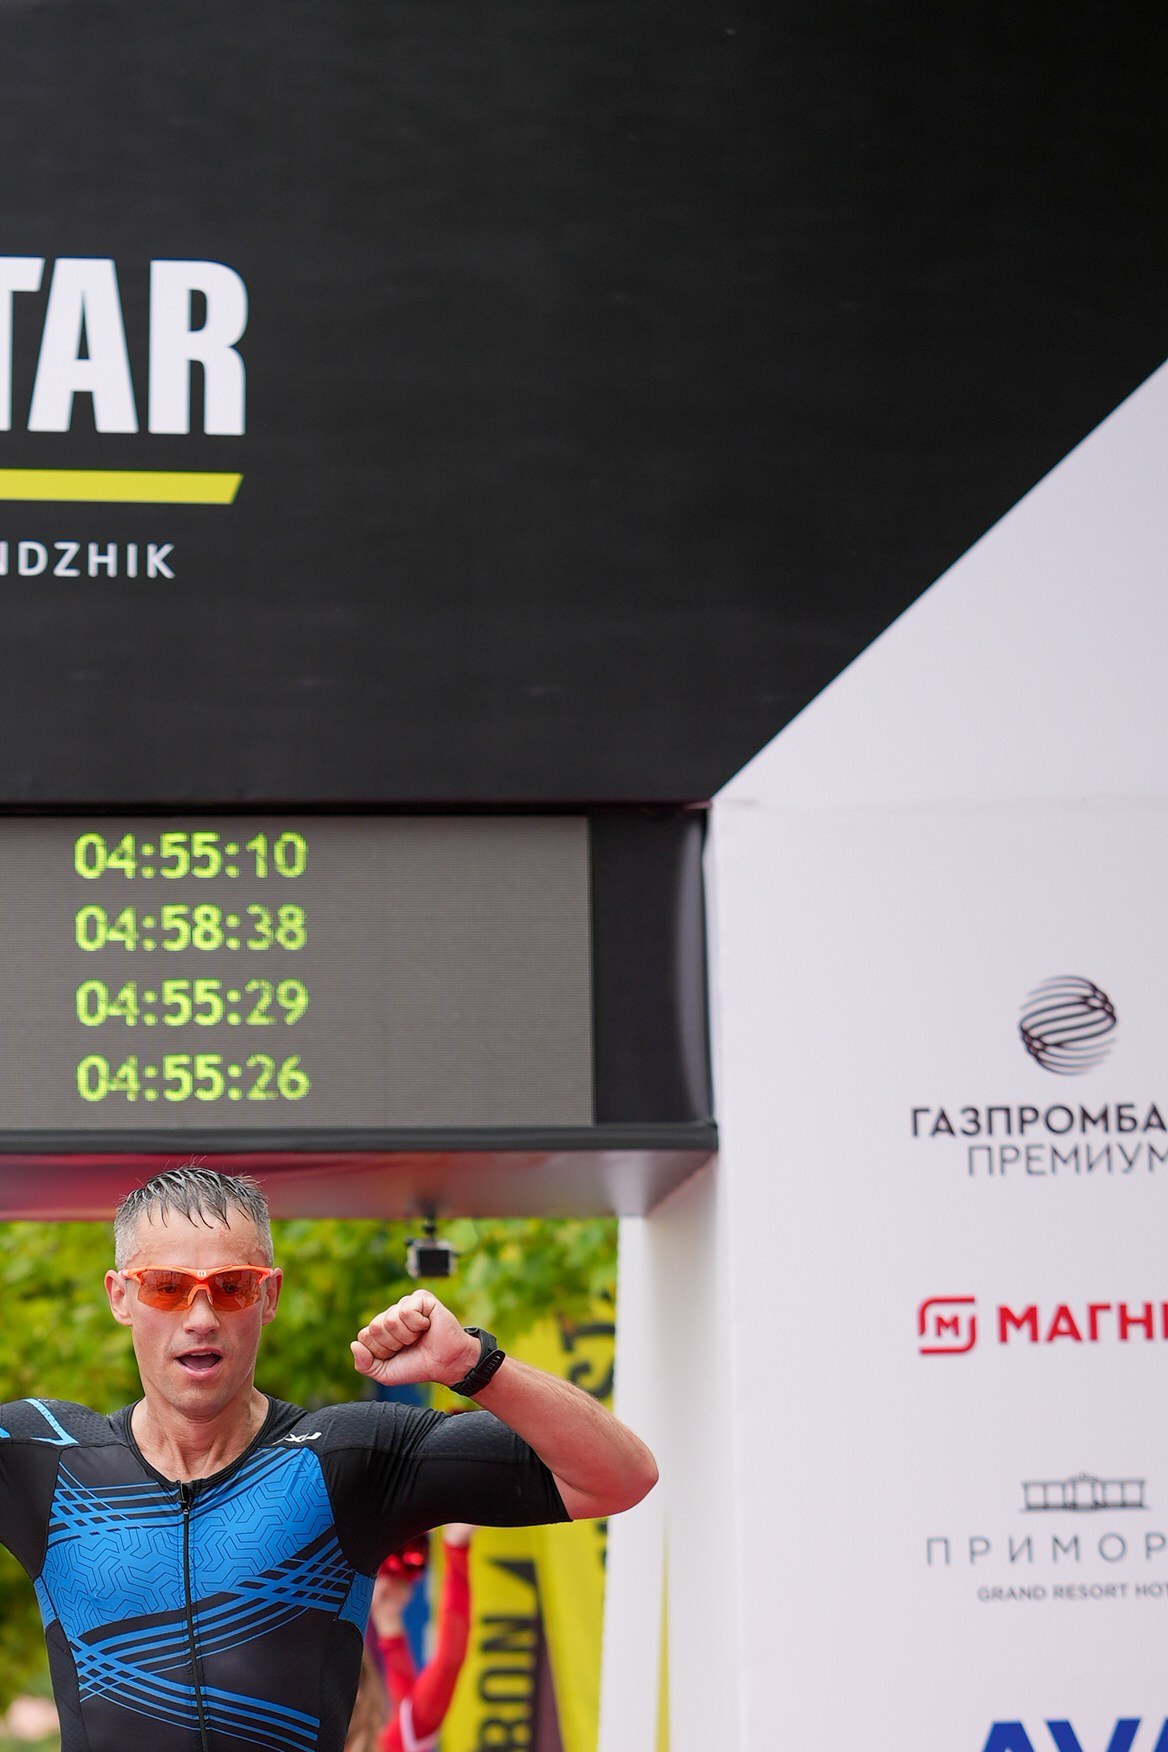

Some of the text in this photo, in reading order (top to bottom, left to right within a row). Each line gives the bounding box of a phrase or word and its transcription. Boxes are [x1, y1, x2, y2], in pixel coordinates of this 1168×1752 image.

[74, 832, 308, 879] 04:55:10
[75, 904, 307, 951] 04:58:38
[76, 979, 308, 1026] 04:55:29
[77, 1054, 311, 1101] 04:55:26
[910, 1102, 1167, 1138] ГАЗПРОМБА
[968, 1142, 1168, 1177] ПРЕМИУМ
[997, 1302, 1168, 1344] МАГН
[926, 1531, 1168, 1567] ПРИМОР
[977, 1582, 1168, 1602] GRAND RESORT HO
